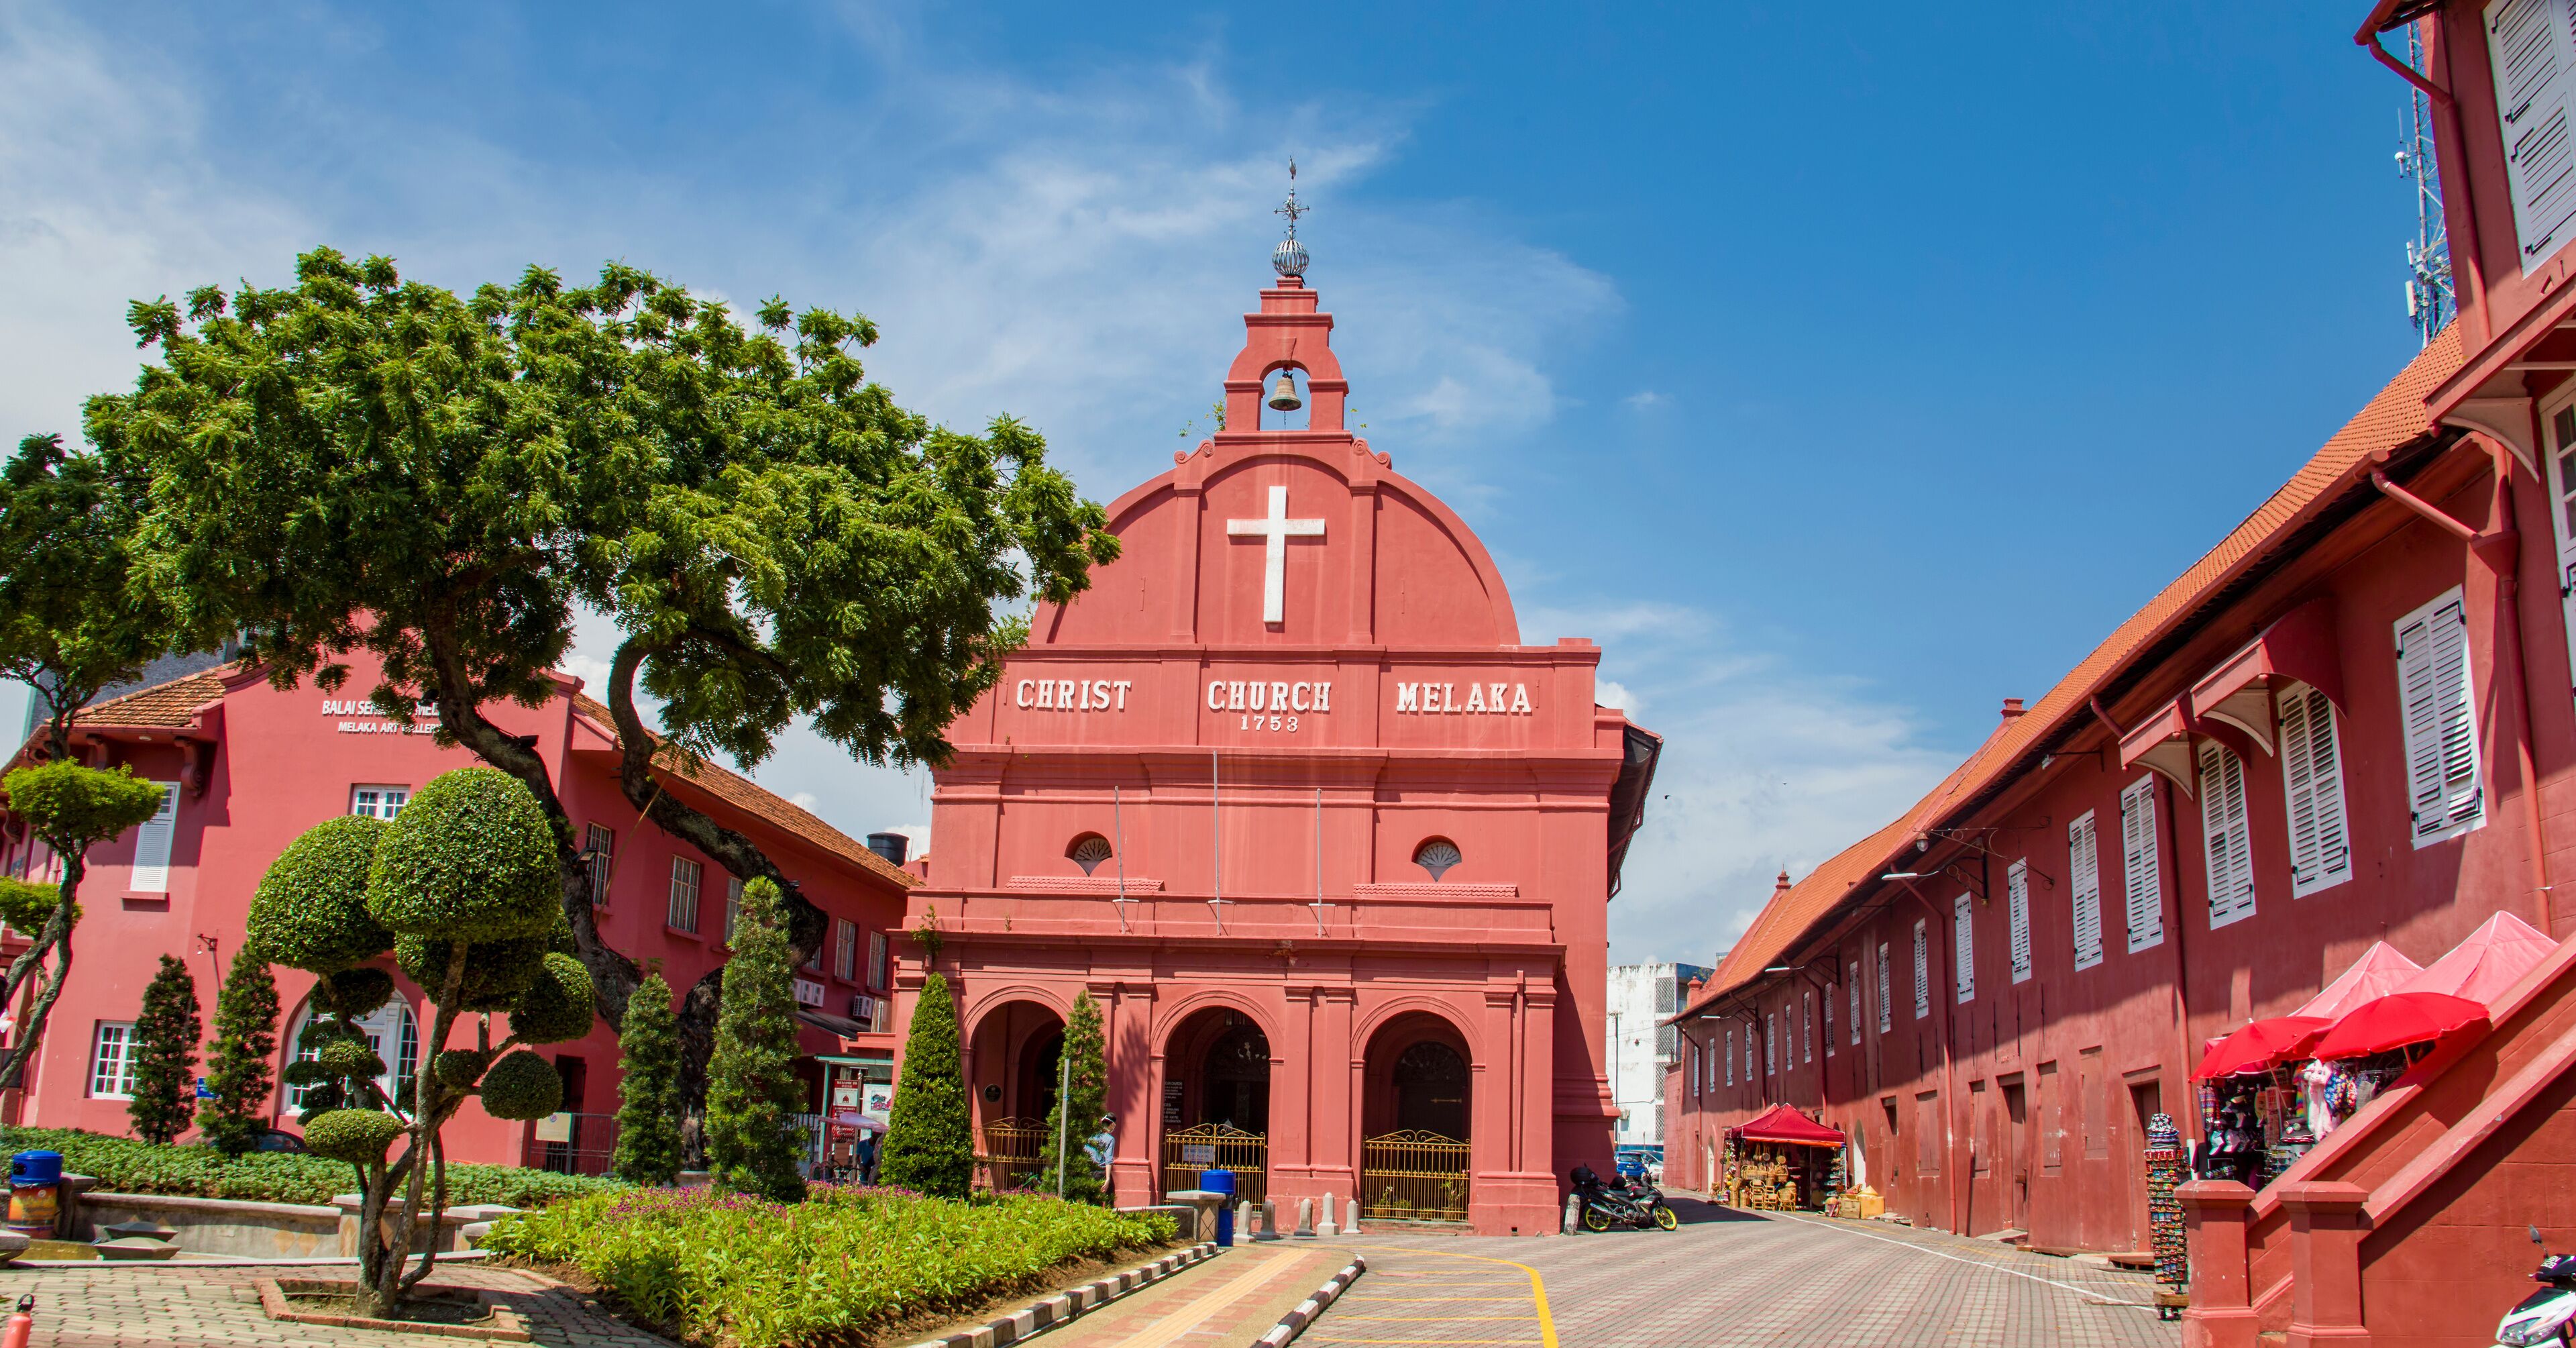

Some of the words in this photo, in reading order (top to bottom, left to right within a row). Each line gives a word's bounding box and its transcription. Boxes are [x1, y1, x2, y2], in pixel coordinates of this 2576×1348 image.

[1016, 679, 1132, 709] CHRIST
[1208, 680, 1332, 712] CHURCH
[1396, 682, 1532, 713] MELAKA
[321, 700, 356, 715] BALAI
[337, 722, 377, 733] MELAKA
[380, 722, 398, 733] ART
[1240, 715, 1299, 732] 1753
